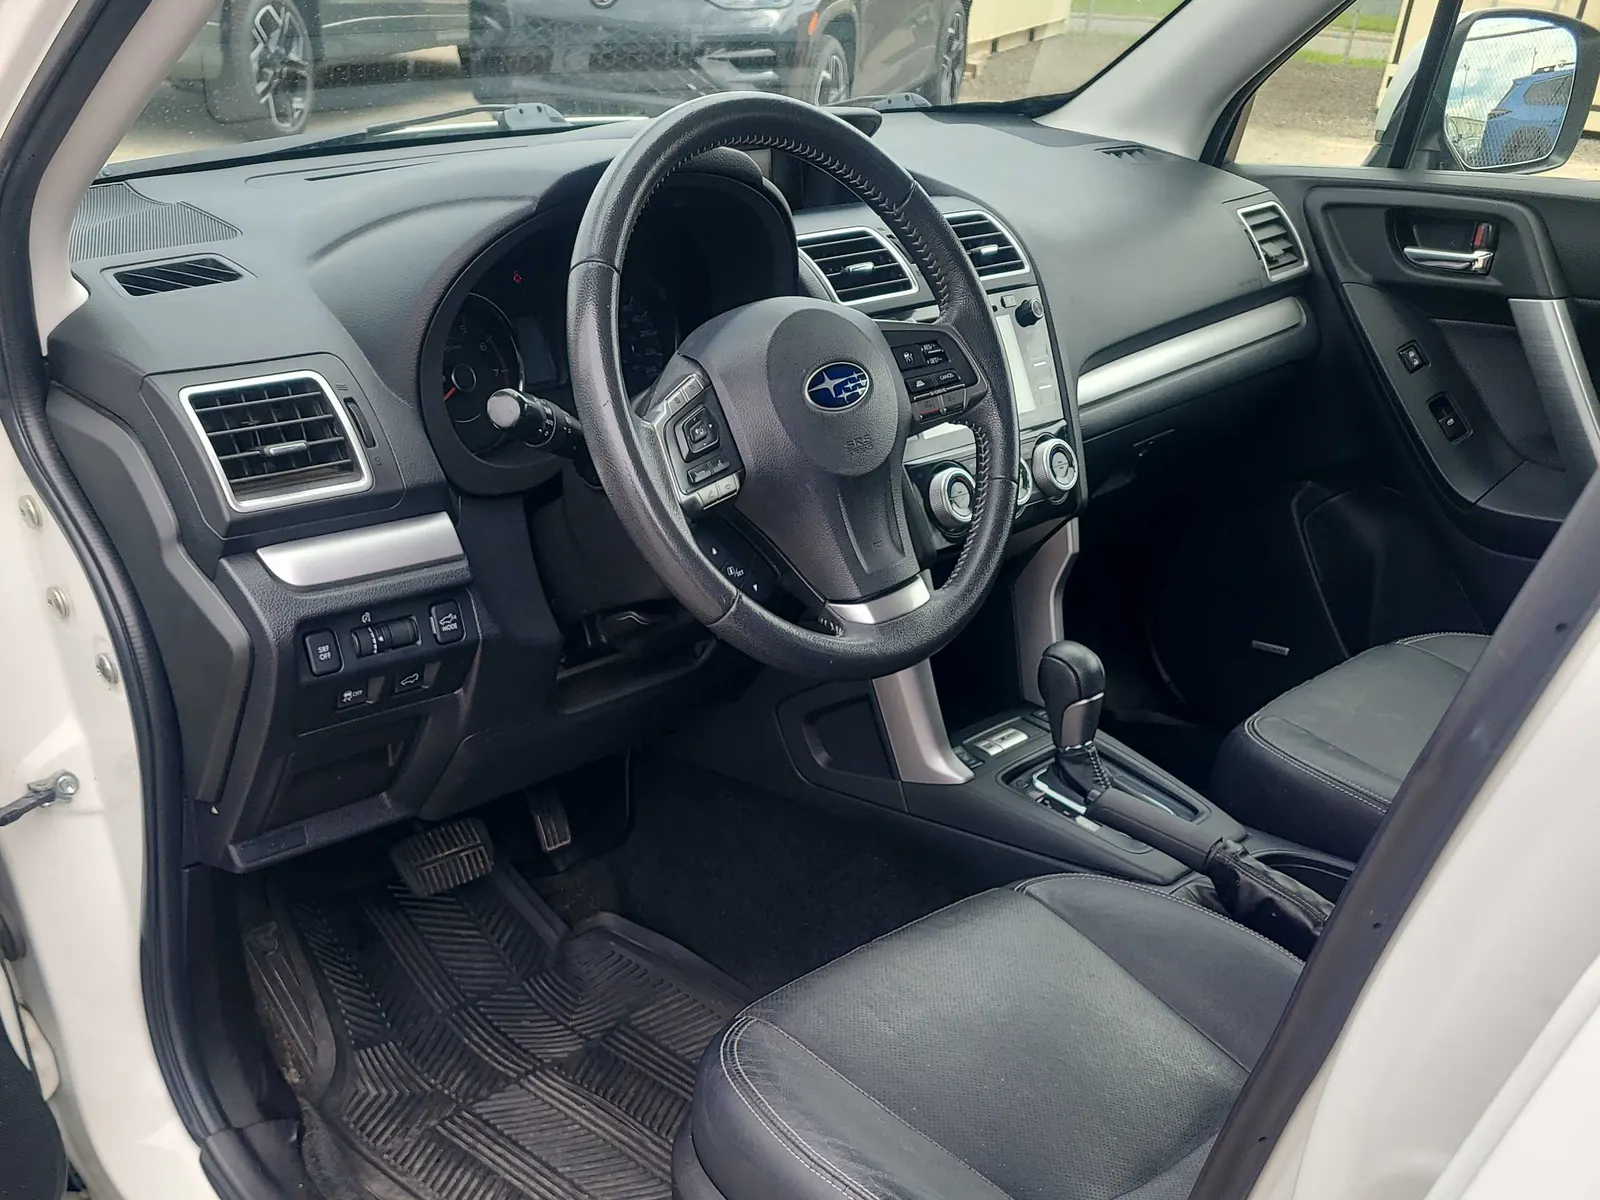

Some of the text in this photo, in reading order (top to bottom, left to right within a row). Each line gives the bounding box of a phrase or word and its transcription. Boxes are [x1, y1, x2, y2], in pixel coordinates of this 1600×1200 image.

[939, 372, 955, 380] CANCEL
[442, 623, 458, 632] MODE
[319, 652, 331, 660] OFF
[352, 689, 363, 697] OFF
